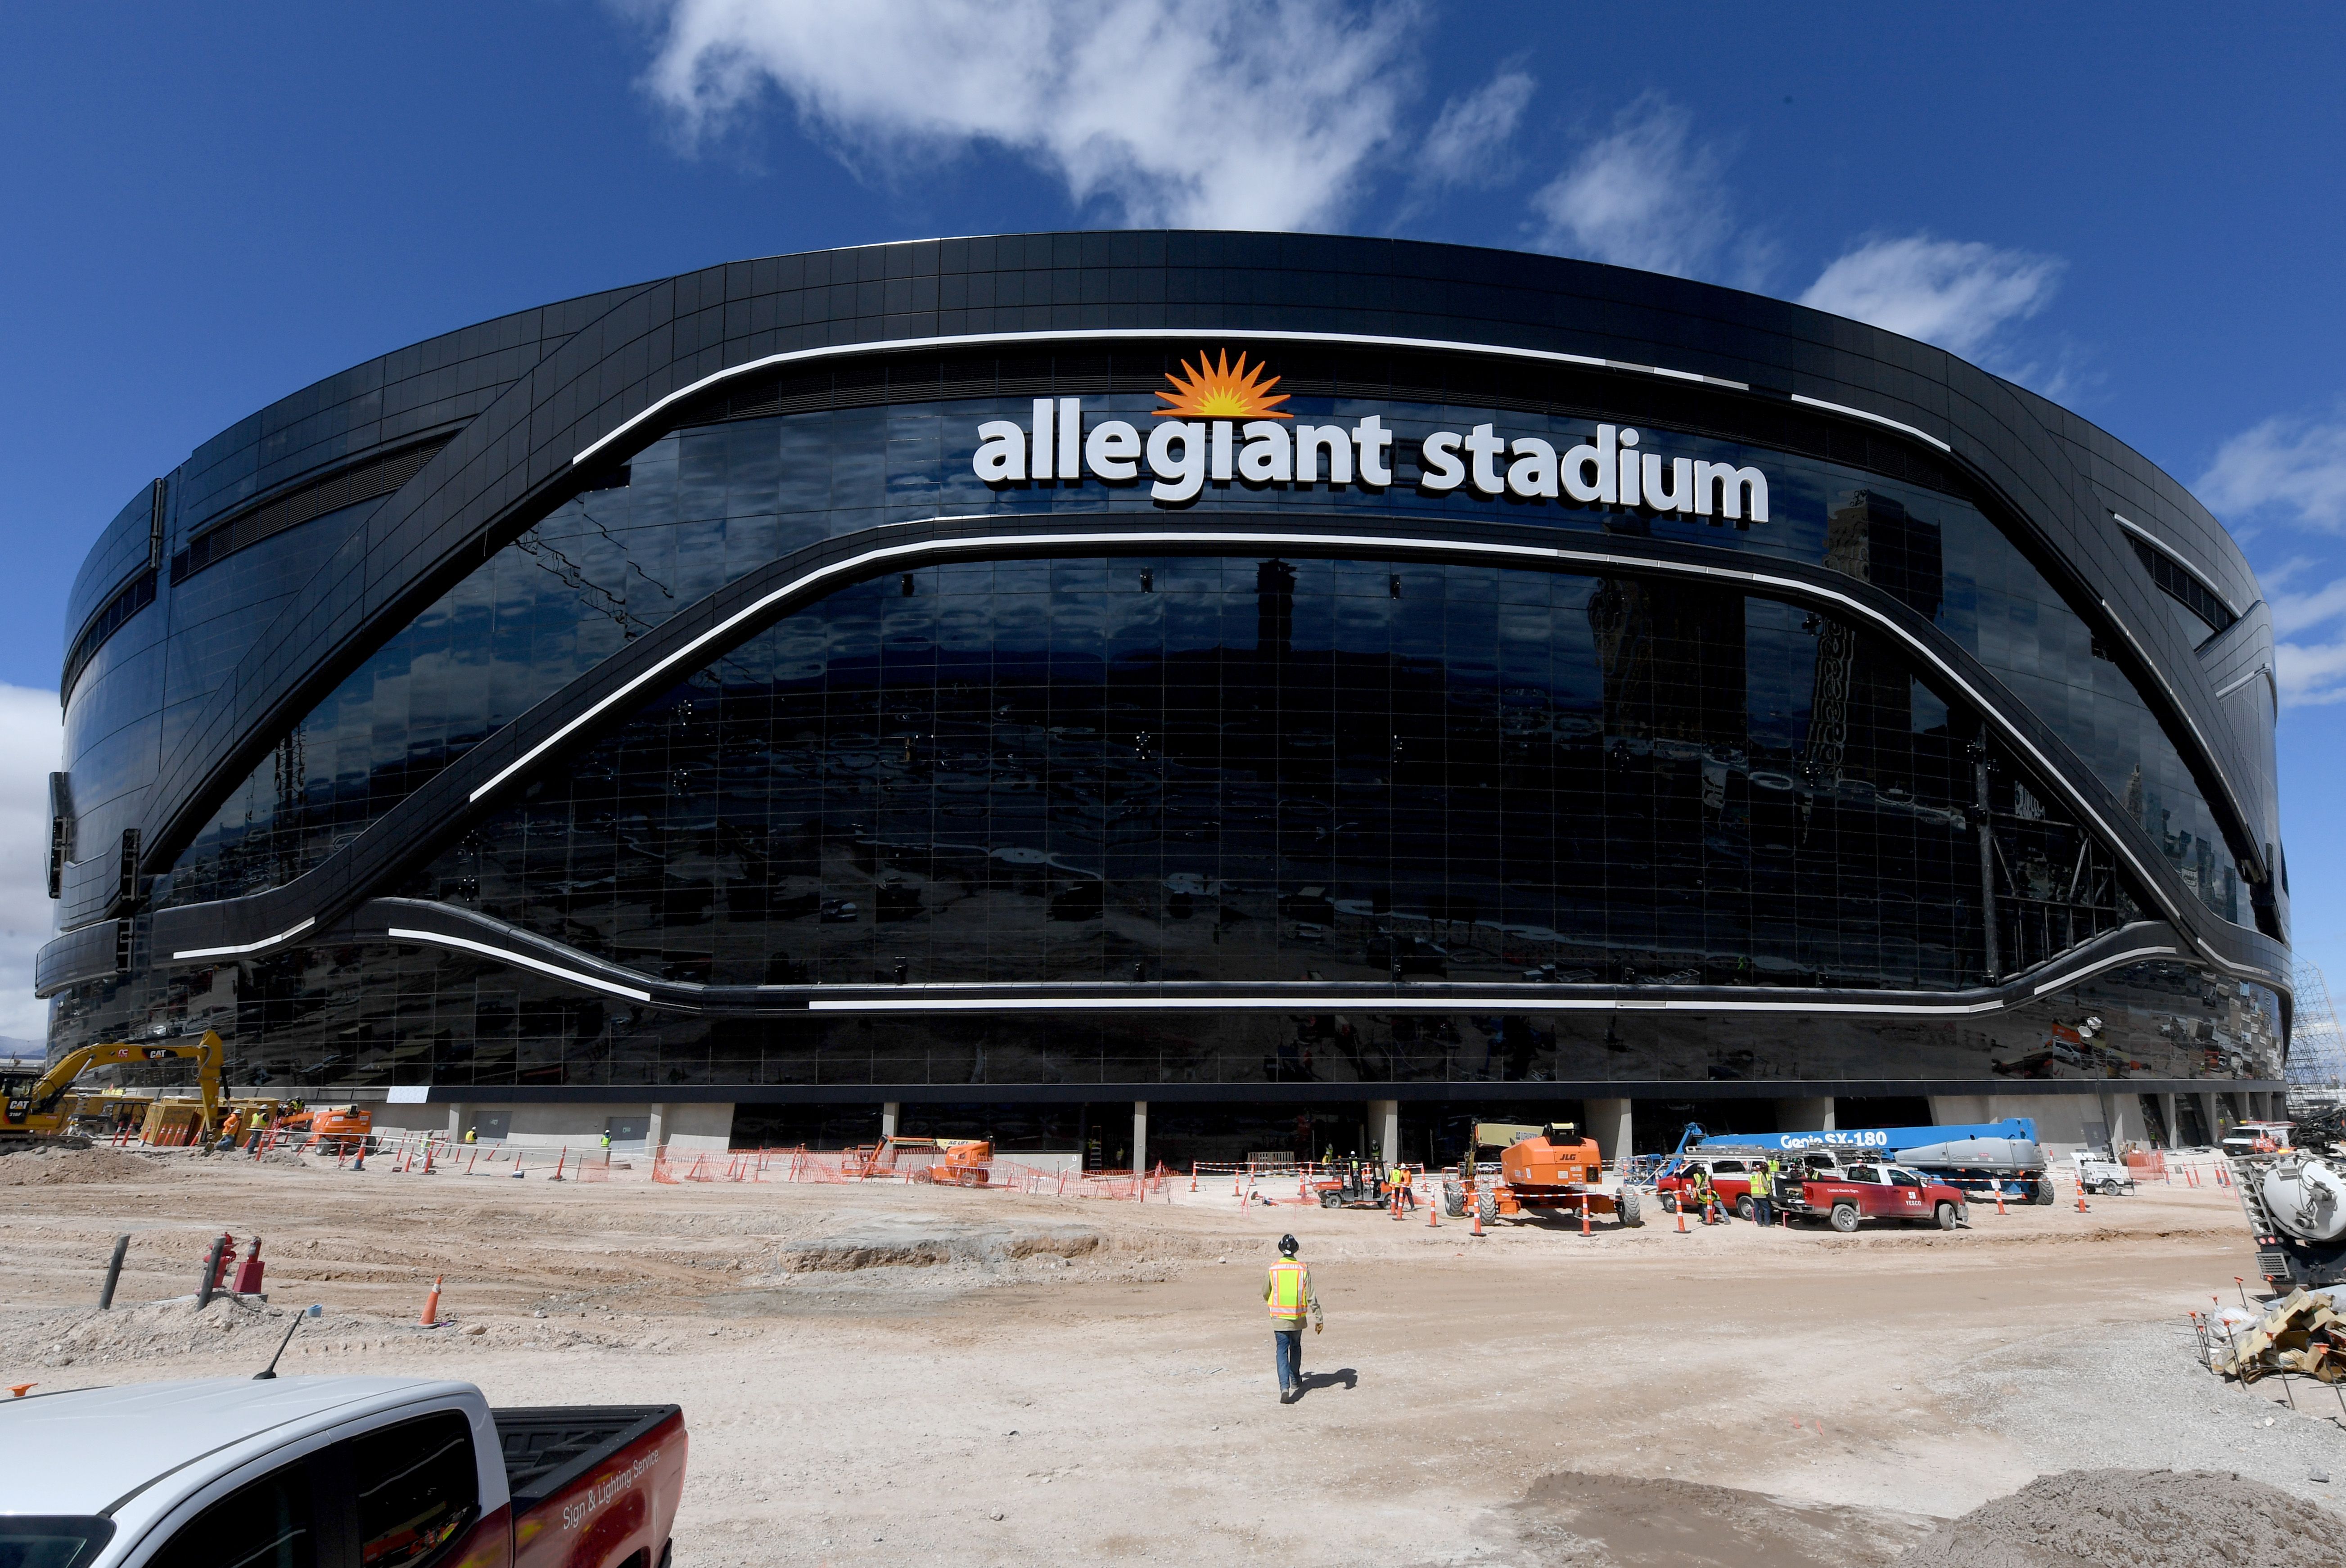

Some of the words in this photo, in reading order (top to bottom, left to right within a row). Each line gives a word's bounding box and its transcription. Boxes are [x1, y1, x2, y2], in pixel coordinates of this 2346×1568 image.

[972, 397, 1392, 501] allegiant
[1421, 423, 1769, 523] stadium
[150, 1050, 167, 1059] CAT
[9, 1100, 30, 1109] CAT
[1824, 1131, 1887, 1147] SX-180
[563, 1502, 585, 1530] Sign
[588, 1490, 596, 1512] &
[598, 1470, 632, 1504] Lighting
